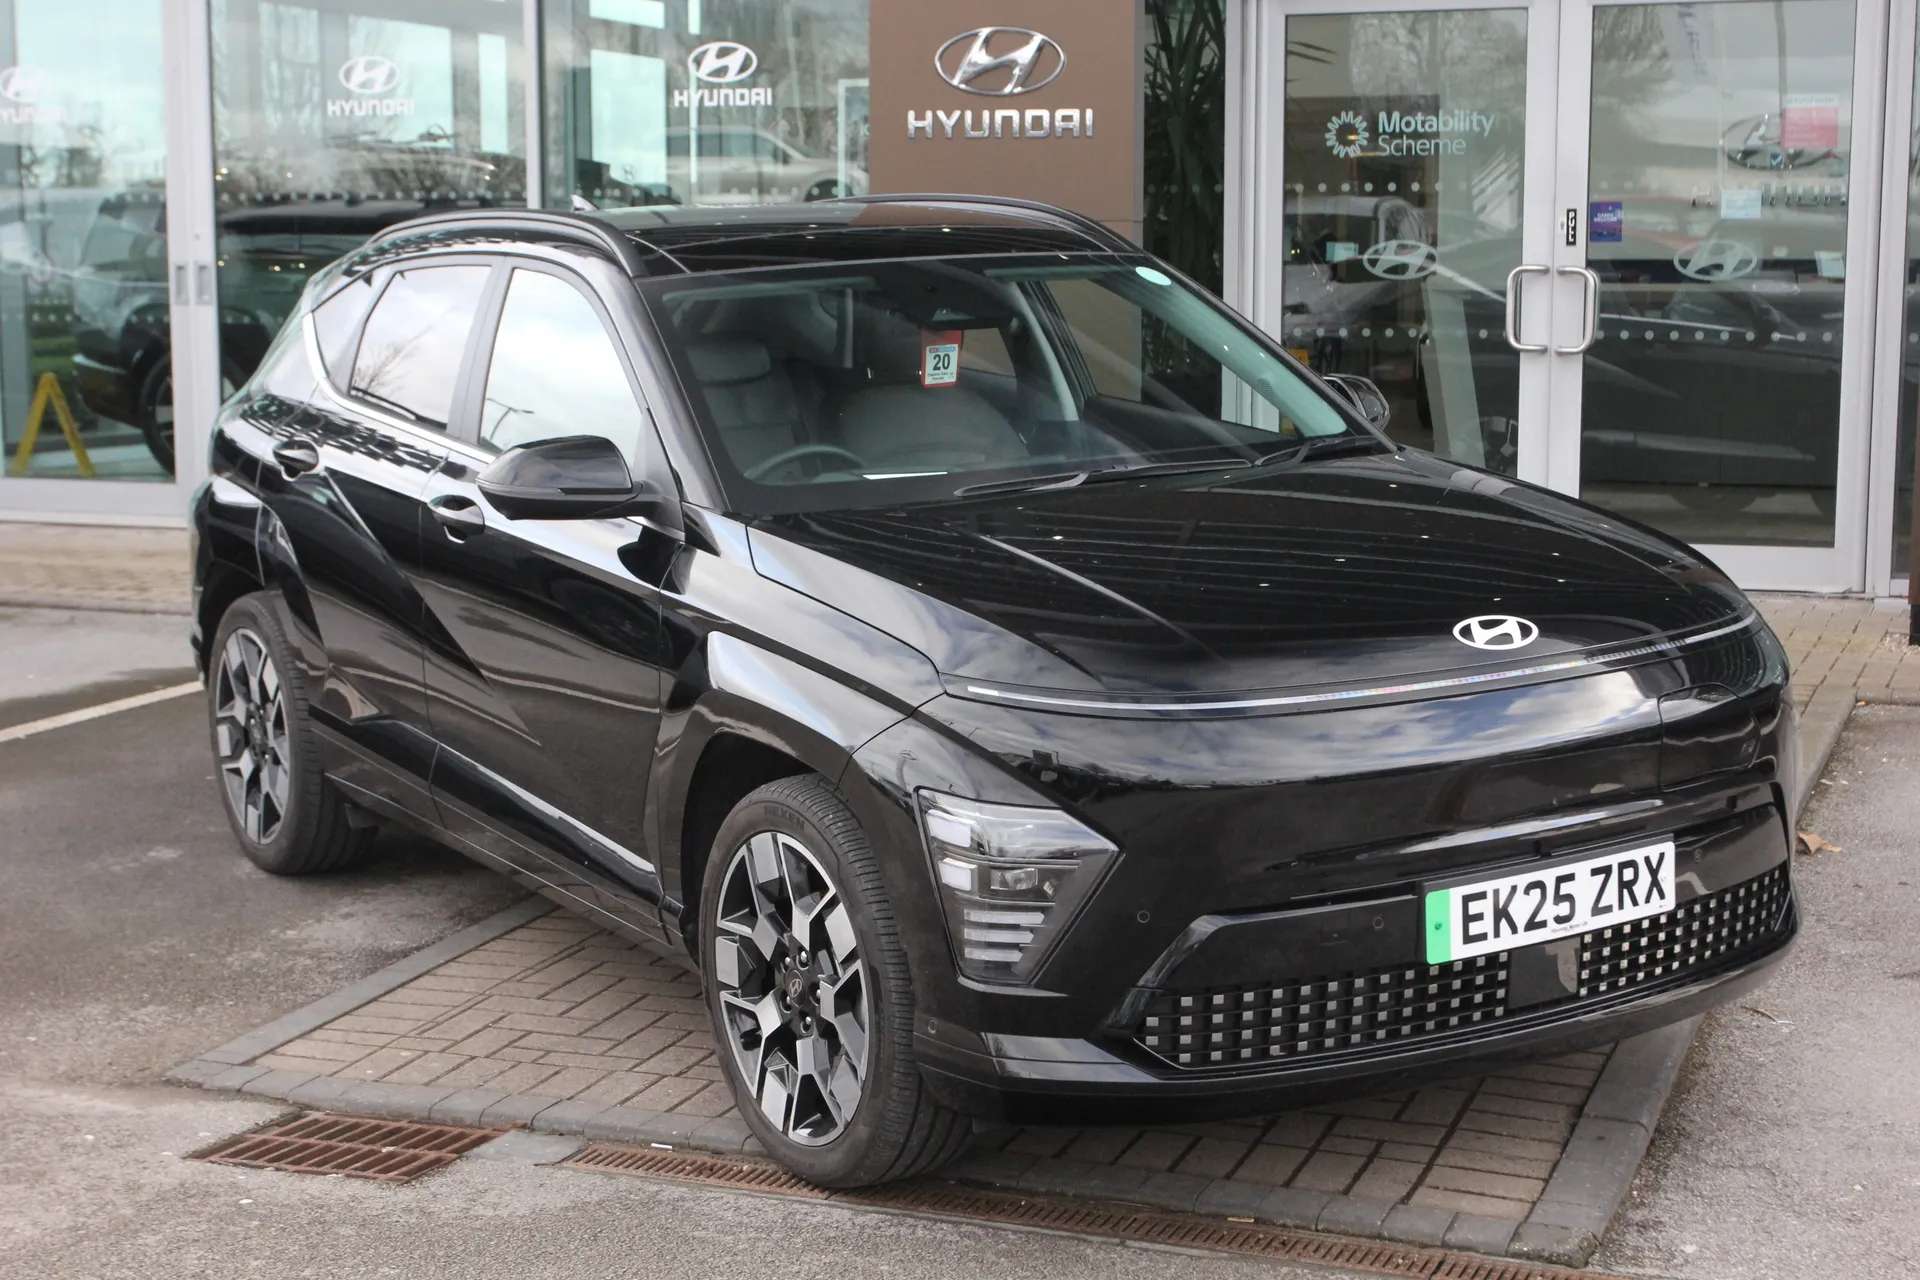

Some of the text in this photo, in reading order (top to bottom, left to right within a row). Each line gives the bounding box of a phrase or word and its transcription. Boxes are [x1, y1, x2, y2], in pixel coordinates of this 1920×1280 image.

[327, 99, 416, 116] HYUNDAI
[673, 87, 772, 107] HYUNDAI
[907, 108, 1093, 138] HYUNDAI
[1378, 110, 1496, 137] Motability
[1378, 134, 1467, 156] Scheme
[932, 353, 951, 371] 20
[1461, 851, 1666, 945] EK25 ZRX
